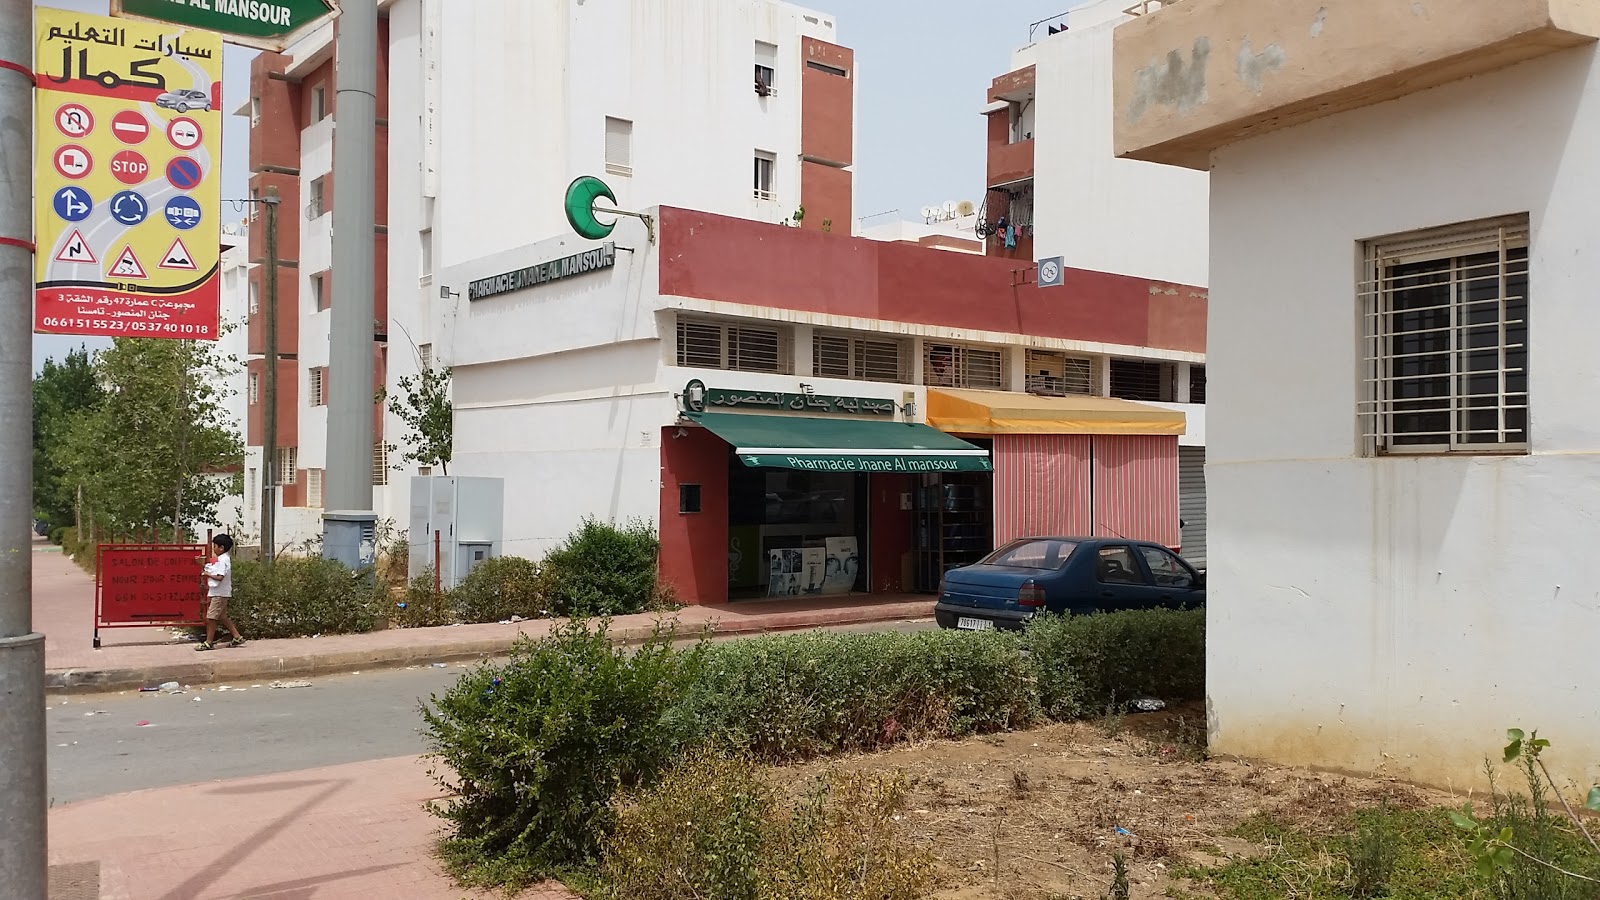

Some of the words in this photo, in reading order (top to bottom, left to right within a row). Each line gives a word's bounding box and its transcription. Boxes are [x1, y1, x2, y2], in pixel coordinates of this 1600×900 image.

[214, 0, 291, 26] MANSOUR
[47, 21, 125, 47] التعليم
[133, 34, 212, 60] سيارات
[46, 46, 166, 89] كمال
[112, 161, 147, 174] STOP
[469, 272, 515, 299] PHARMACIE
[517, 266, 547, 288] JNANE
[547, 262, 560, 281] AL
[58, 294, 64, 302] 3
[711, 392, 784, 406] المنصور
[789, 394, 831, 411] جنان
[786, 456, 855, 470] Pharmacie
[857, 457, 893, 471] Jnane
[895, 457, 906, 471] Al
[908, 459, 958, 471] mansour
[111, 558, 144, 567] SALON
[147, 557, 159, 566] DE
[112, 575, 137, 584] NOUR
